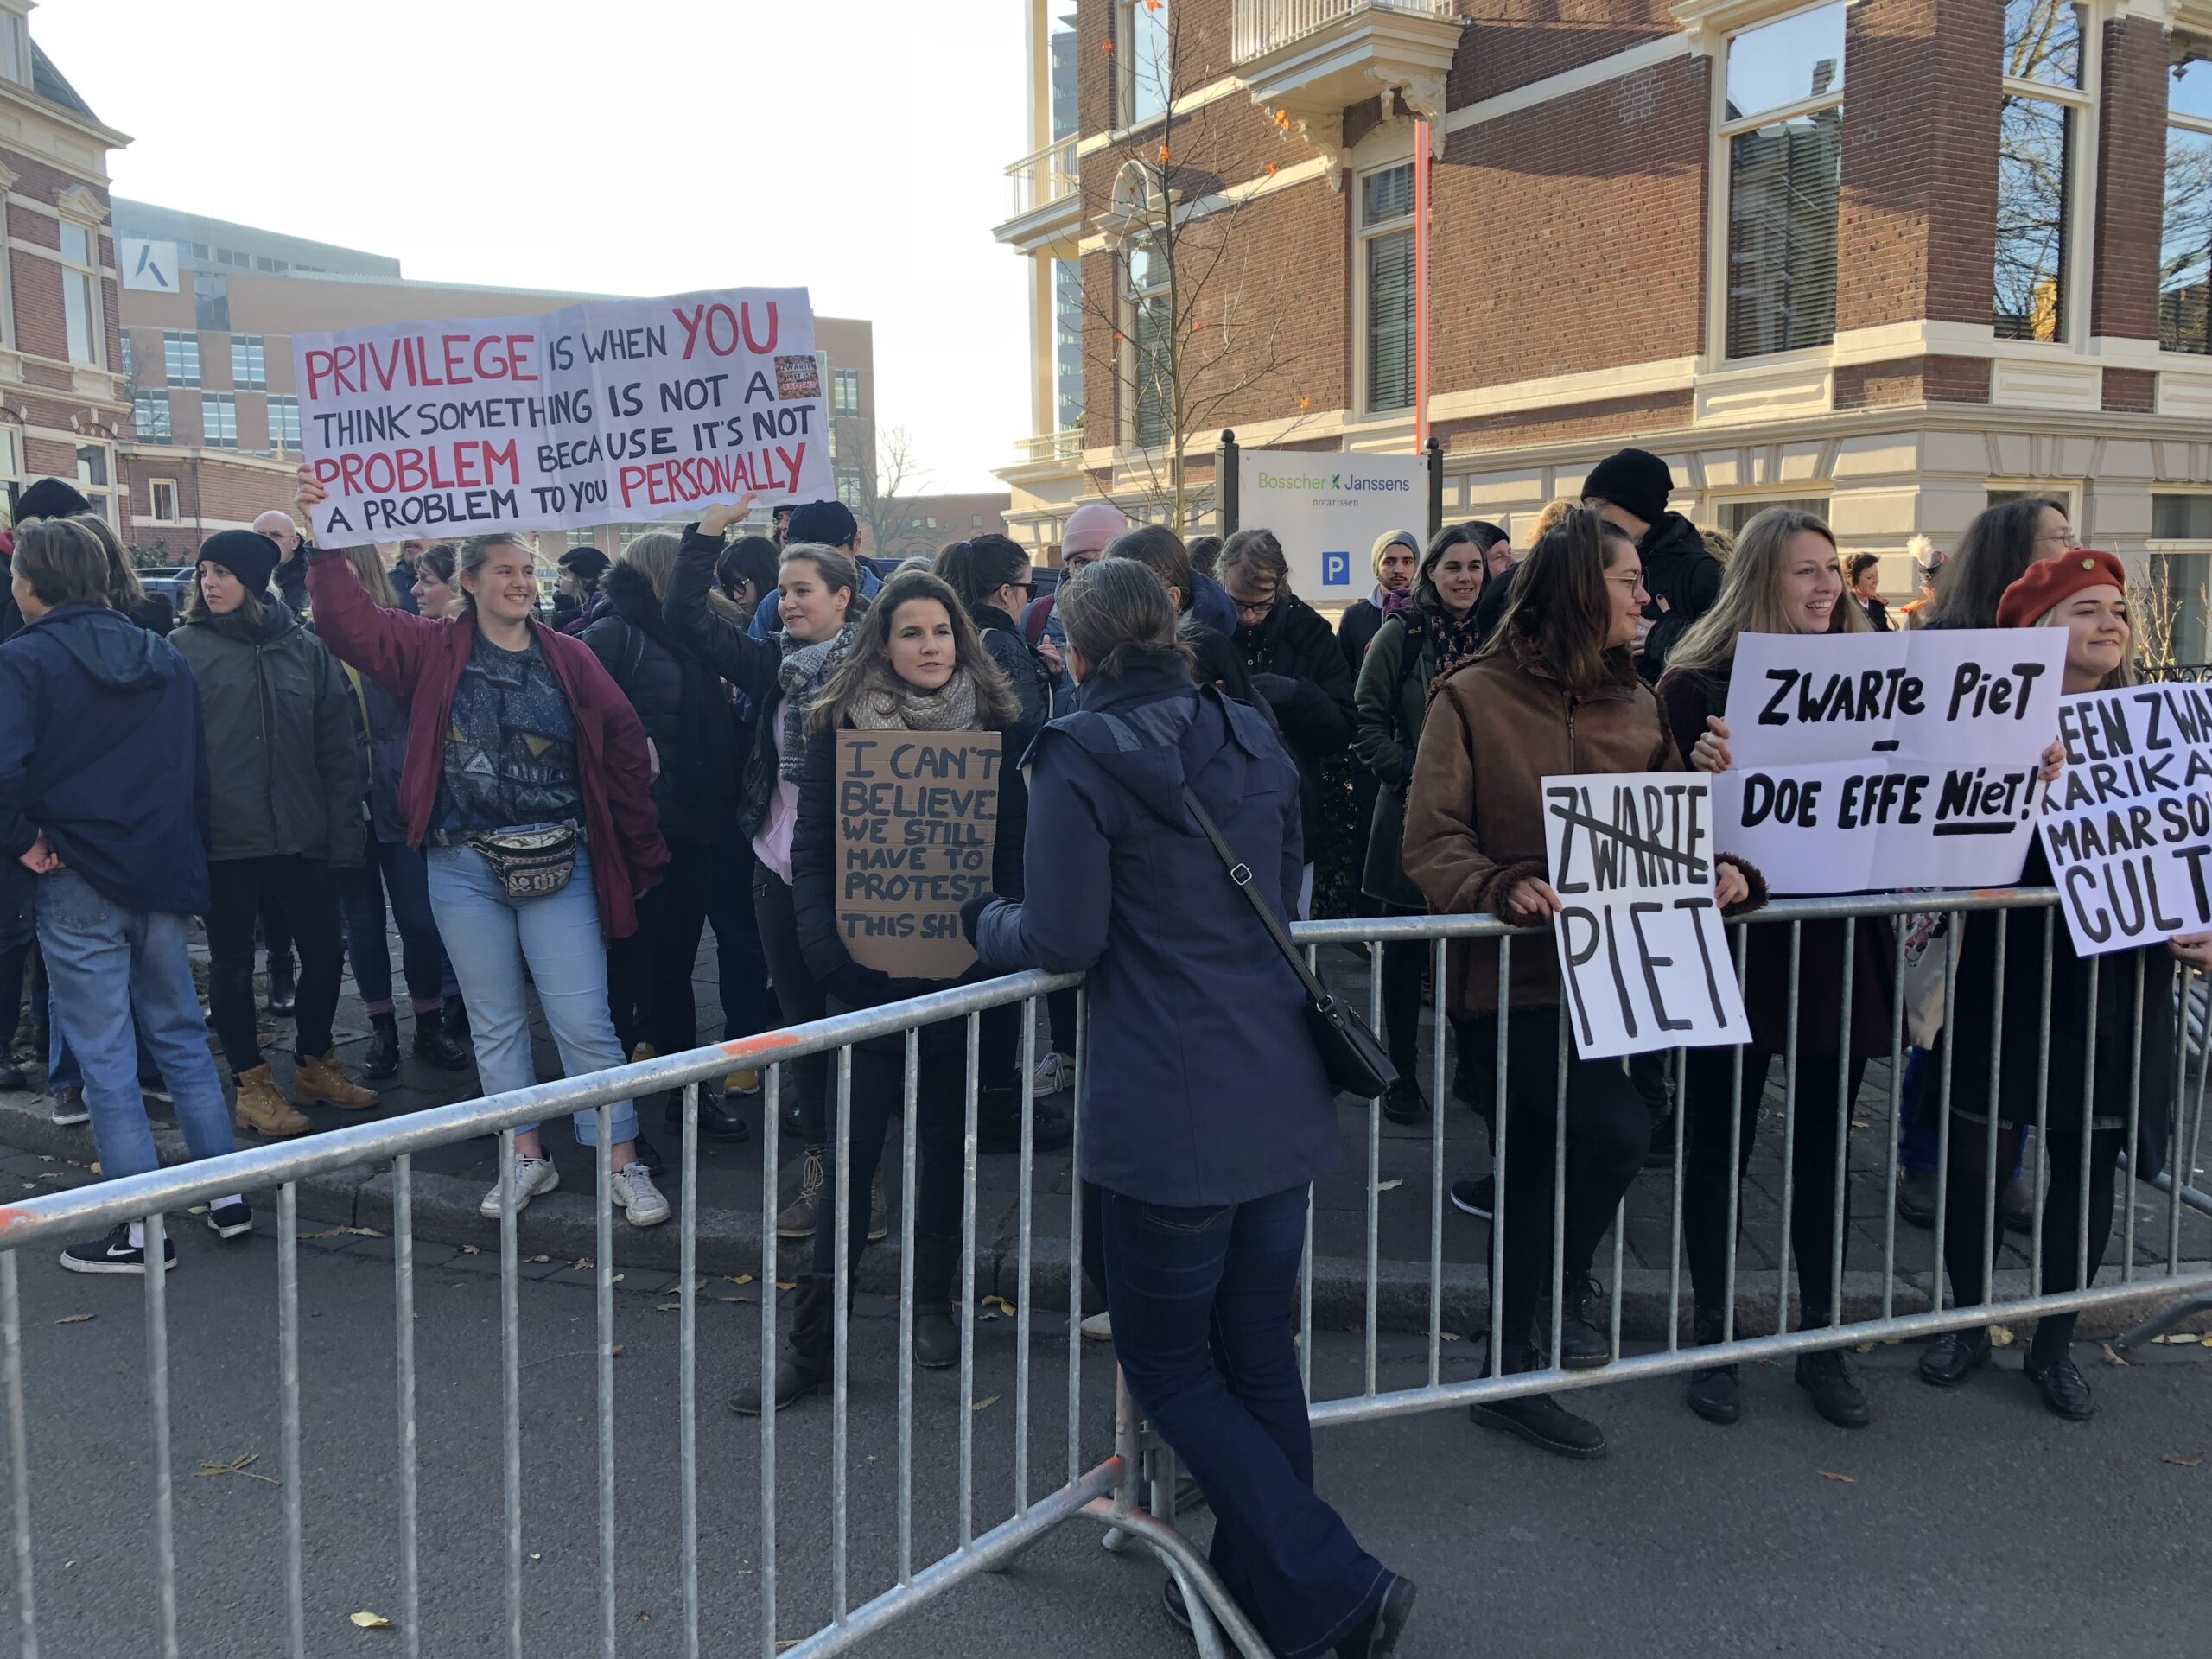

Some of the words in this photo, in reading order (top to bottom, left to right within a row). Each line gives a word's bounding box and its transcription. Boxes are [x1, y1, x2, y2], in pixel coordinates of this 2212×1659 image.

[305, 334, 539, 400] PRIVILEGE
[550, 335, 574, 371] IS
[582, 325, 668, 364] WHEN
[671, 301, 779, 360] YOU
[781, 363, 811, 372] ZWARTE
[313, 404, 412, 448] THINK
[416, 388, 593, 435] SOMETHING
[607, 382, 644, 418] IS
[659, 373, 728, 413] NOT
[743, 370, 776, 404] A
[314, 437, 520, 497] PROBLEM
[537, 426, 677, 473] BECAUSE
[692, 416, 744, 452] IT'S
[752, 404, 816, 441] NOT
[326, 505, 353, 533] A
[363, 488, 519, 531] PROBLEM
[531, 486, 566, 514] TO
[569, 479, 607, 512] YOU
[619, 442, 807, 508] PERSONALLY
[1258, 471, 1327, 490] Bosscher
[1344, 474, 1410, 492] Janssens
[1313, 497, 1359, 507] notarissen
[1328, 556, 1344, 582] P
[1946, 661, 2047, 722] PieT
[843, 741, 879, 778] I
[889, 742, 1003, 780] CAN'T
[2056, 697, 2134, 766] EEN
[839, 780, 997, 821] BELIEVE
[1740, 772, 1823, 829] DOE
[1837, 773, 1930, 830] EFFE
[2041, 748, 2212, 816] KARIKA
[842, 816, 889, 844] WE
[903, 818, 985, 847] STILL
[1546, 784, 1710, 894] ZWARTE
[2045, 804, 2158, 866] MAAR
[2158, 791, 2212, 843] SO
[844, 871, 992, 902] PROTEST
[845, 846, 928, 871] HAVE
[943, 849, 985, 871] TO
[2064, 843, 2212, 944] CULT
[840, 912, 916, 939] THIS
[919, 913, 965, 939] SH
[1560, 897, 1728, 1046] PIET
